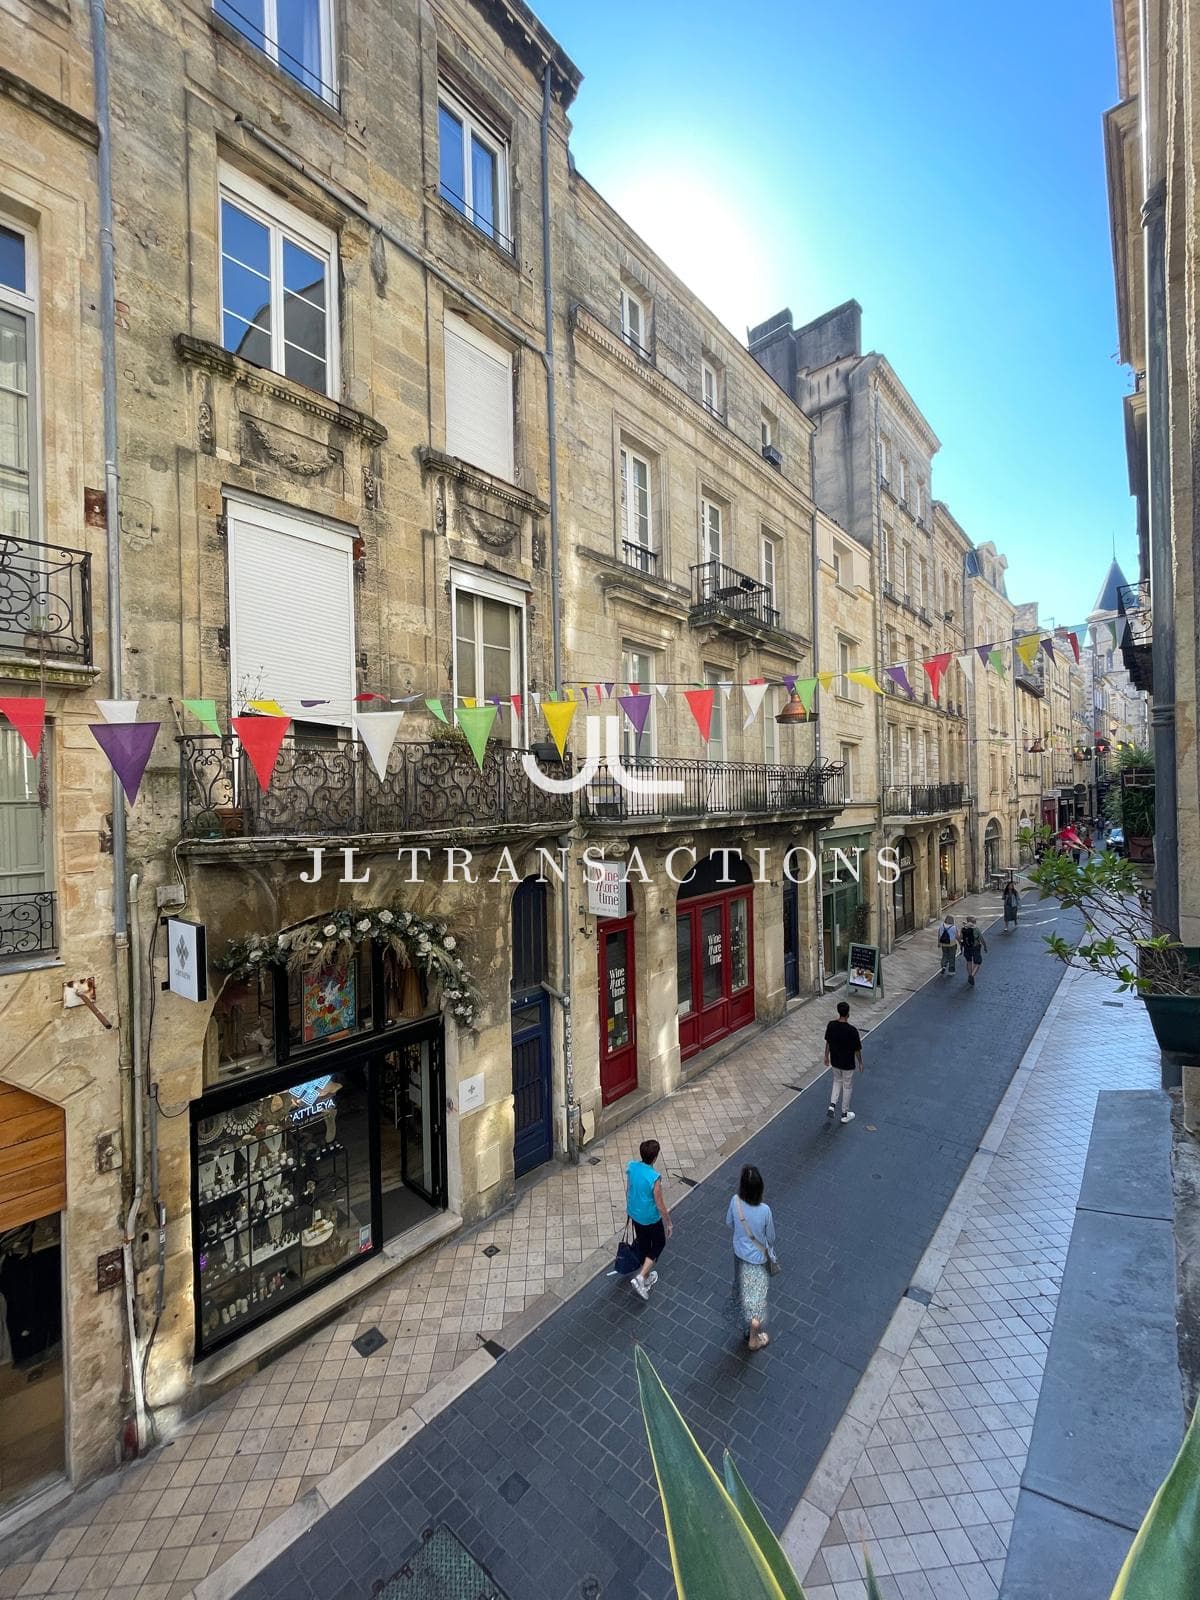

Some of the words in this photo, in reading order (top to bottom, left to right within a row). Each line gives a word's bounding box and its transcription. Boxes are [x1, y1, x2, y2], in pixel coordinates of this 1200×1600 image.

[599, 893, 619, 905] time
[708, 933, 722, 945] Wine
[609, 967, 625, 979] Wine
[609, 977, 625, 990] More
[611, 986, 626, 998] time
[289, 1099, 336, 1121] ATTLEYA
